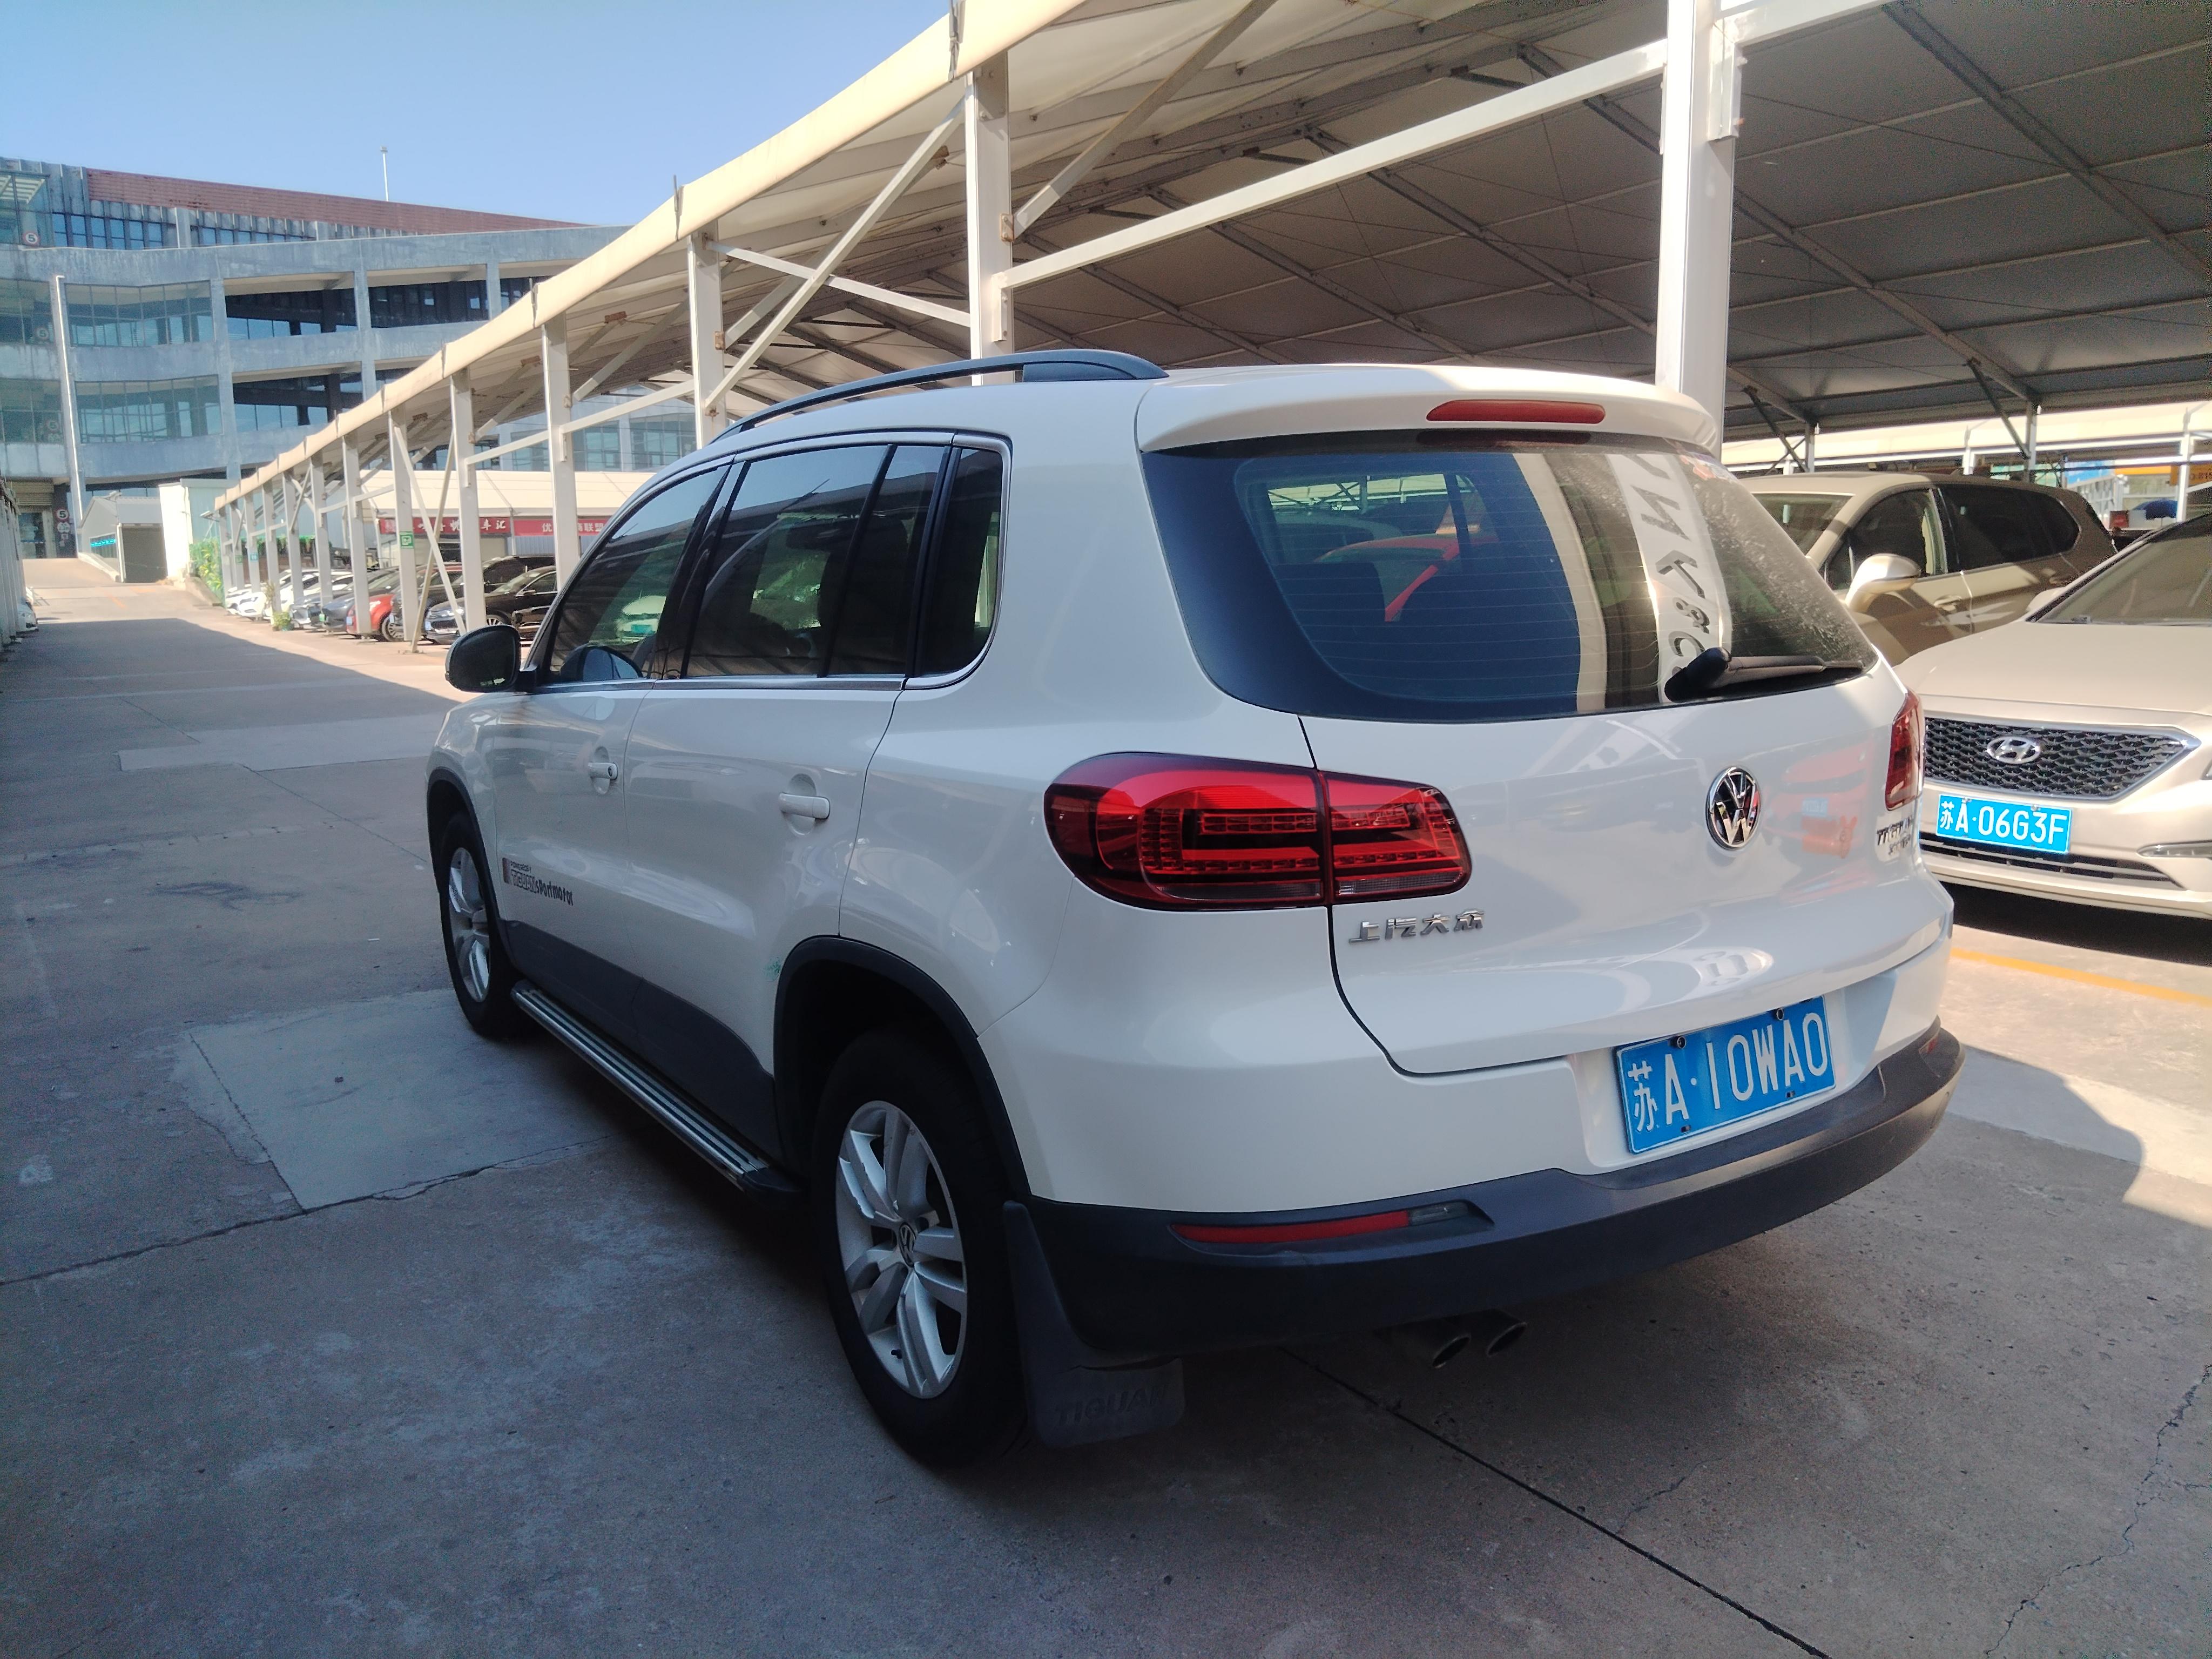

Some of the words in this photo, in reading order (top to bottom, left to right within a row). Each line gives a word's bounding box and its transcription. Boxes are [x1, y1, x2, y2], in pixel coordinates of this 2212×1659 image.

[59, 510, 66, 518] 5
[1348, 909, 1484, 943] 上汽大众
